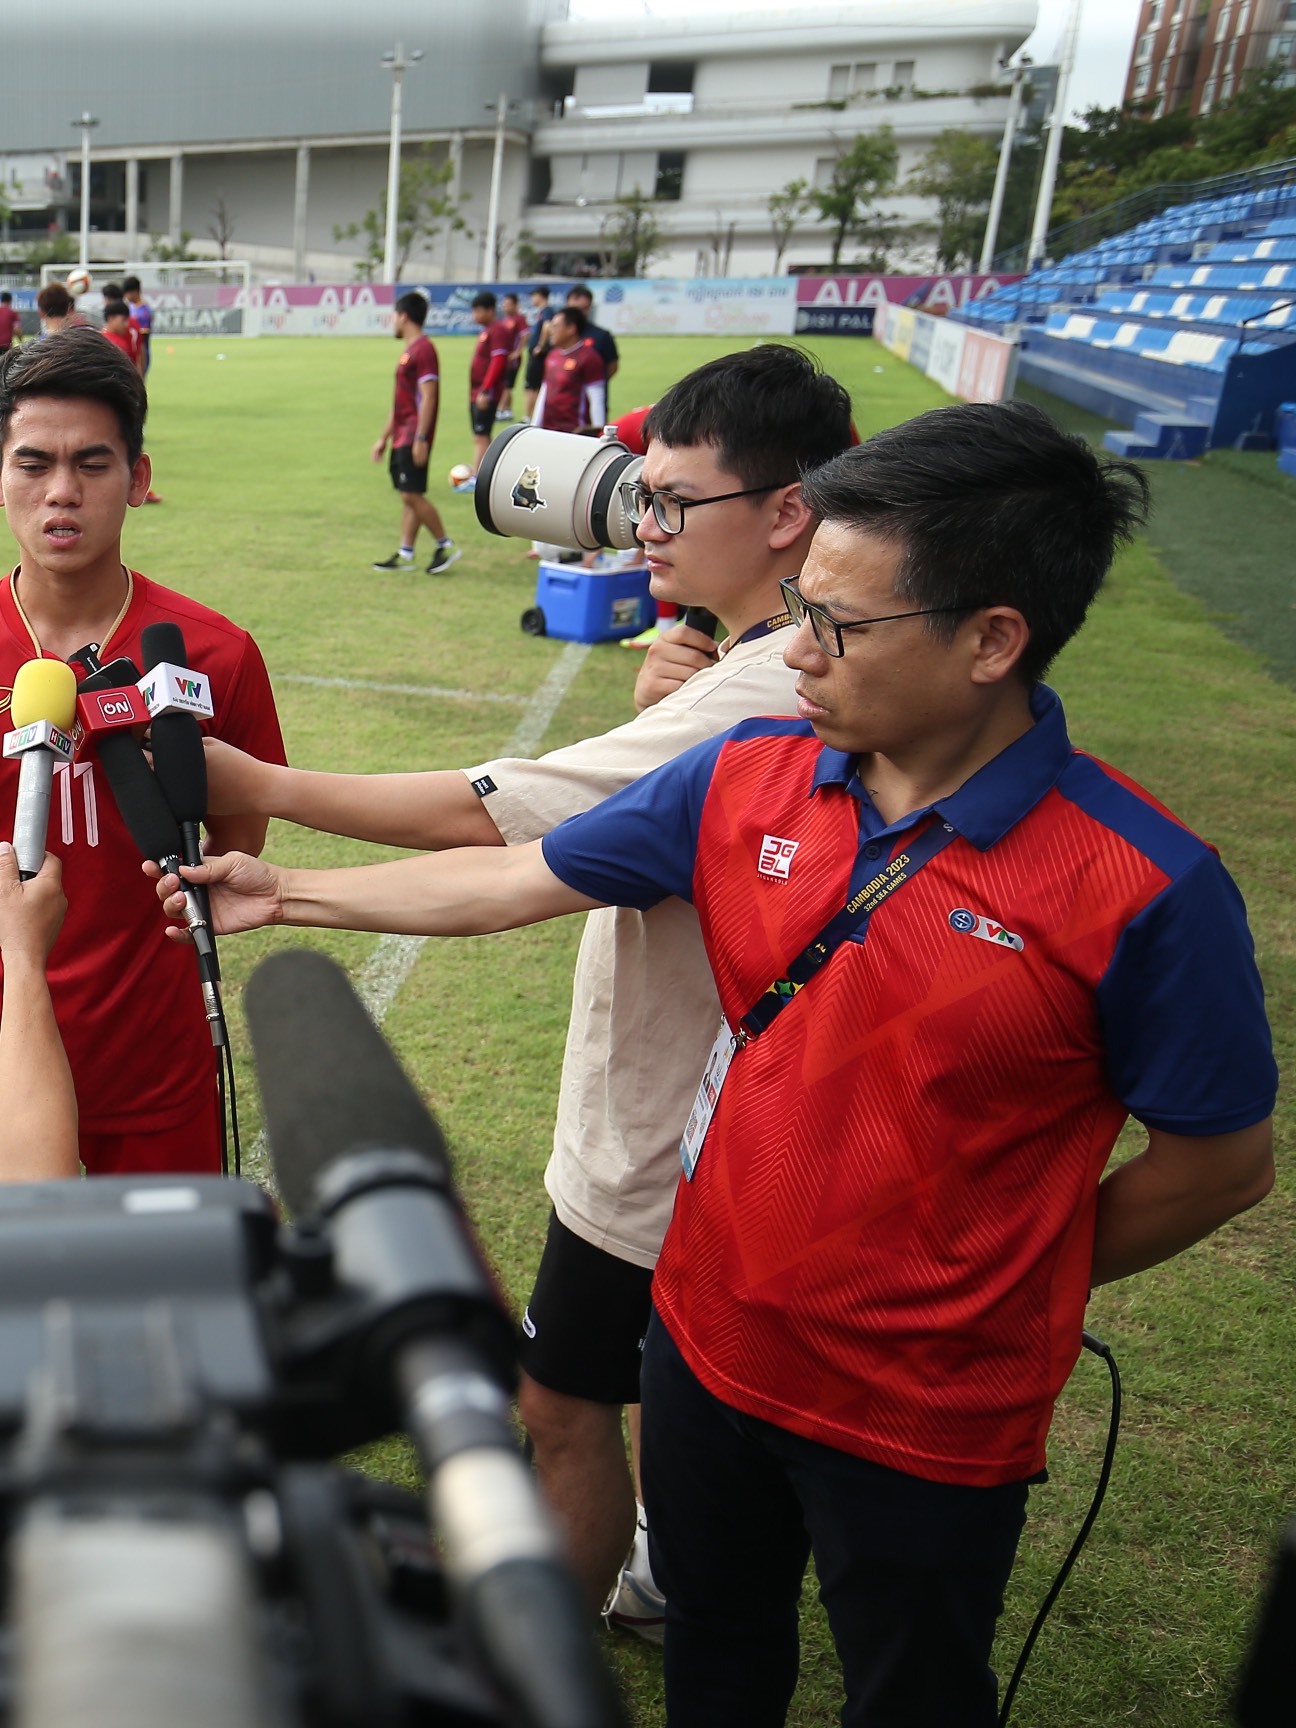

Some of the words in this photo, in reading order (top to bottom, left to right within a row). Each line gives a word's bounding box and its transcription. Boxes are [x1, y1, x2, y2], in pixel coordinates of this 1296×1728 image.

[319, 286, 377, 307] AIA
[813, 279, 888, 307] AIA
[838, 313, 873, 329] PAL
[766, 613, 793, 628] CAMB
[175, 676, 202, 699] VTV
[103, 700, 130, 716] ON
[8, 725, 38, 751] HTV
[49, 727, 72, 755] HTV
[52, 761, 99, 848] 11
[846, 872, 890, 914] CAMBODIA
[885, 853, 911, 877] 2023
[863, 898, 879, 912] 32nd
[875, 889, 889, 904] SEA
[886, 871, 908, 891] GAMES
